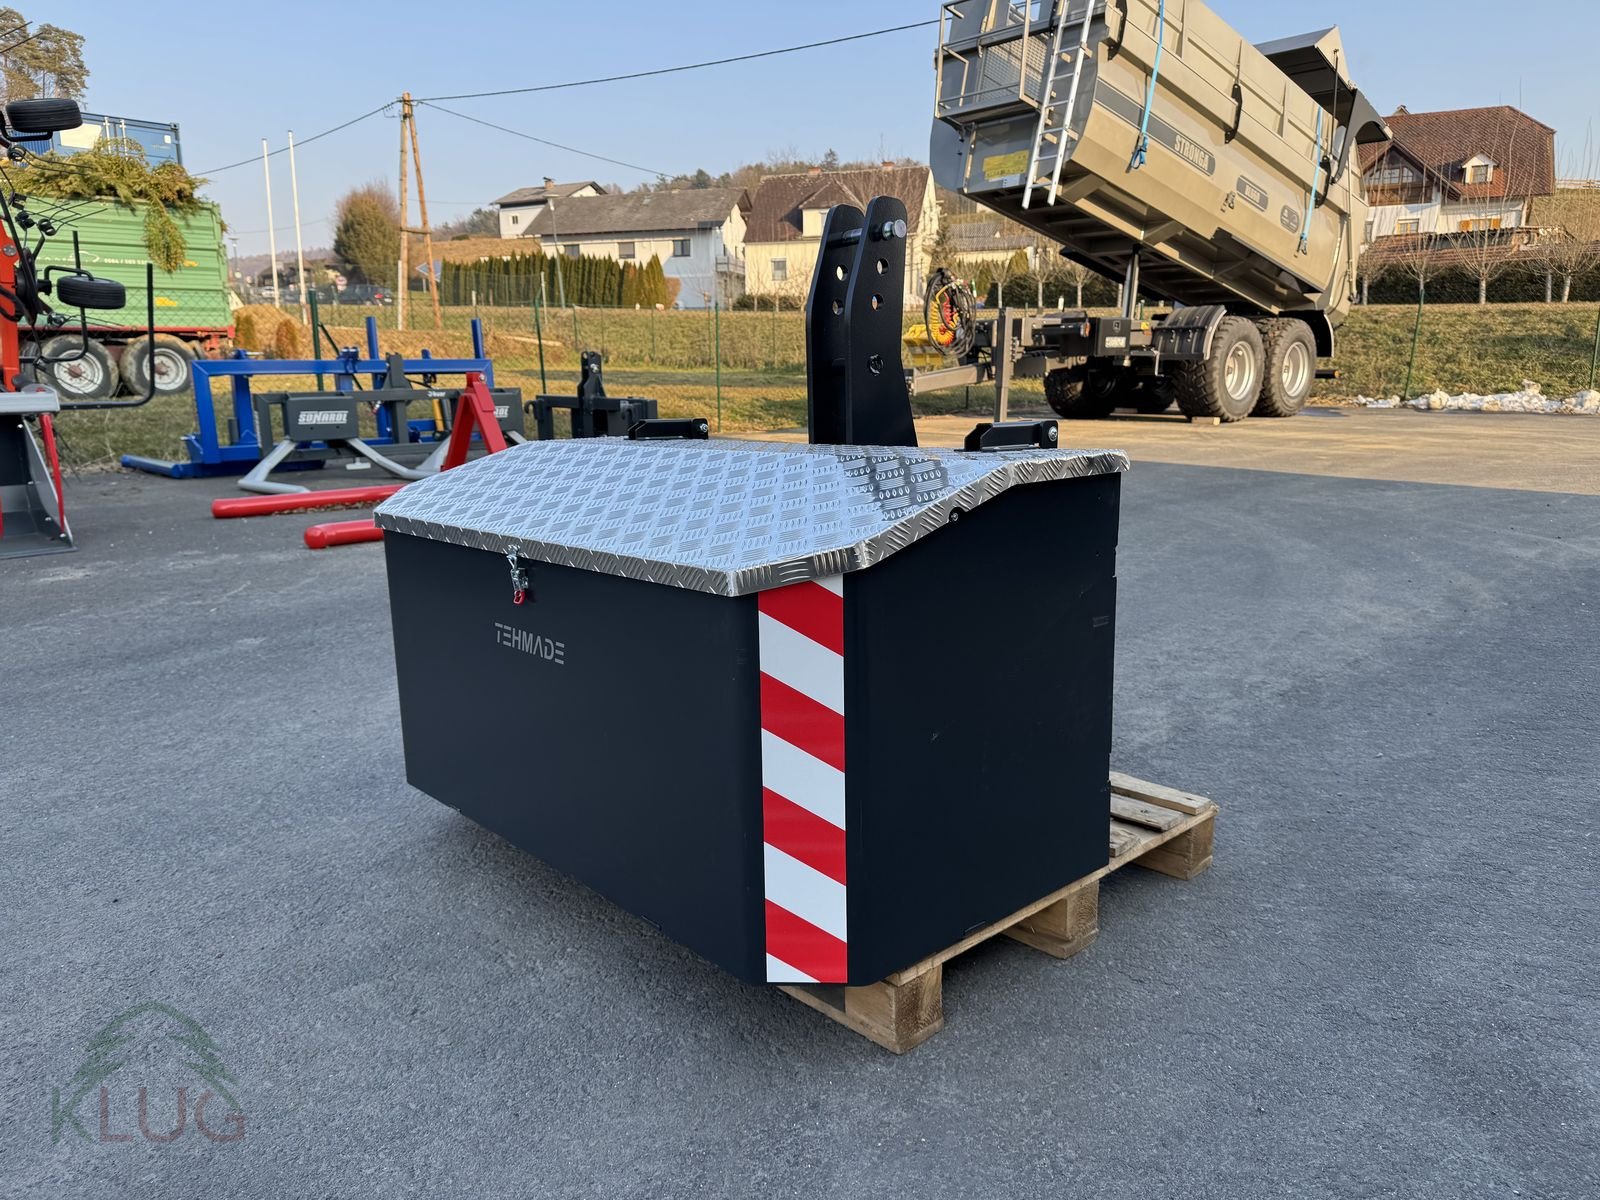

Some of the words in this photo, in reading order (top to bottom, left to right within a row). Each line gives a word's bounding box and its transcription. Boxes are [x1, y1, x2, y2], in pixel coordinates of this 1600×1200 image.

[1174, 134, 1209, 171] STRONGA
[298, 410, 348, 424] SONAROL
[494, 621, 565, 665] TEHMADE
